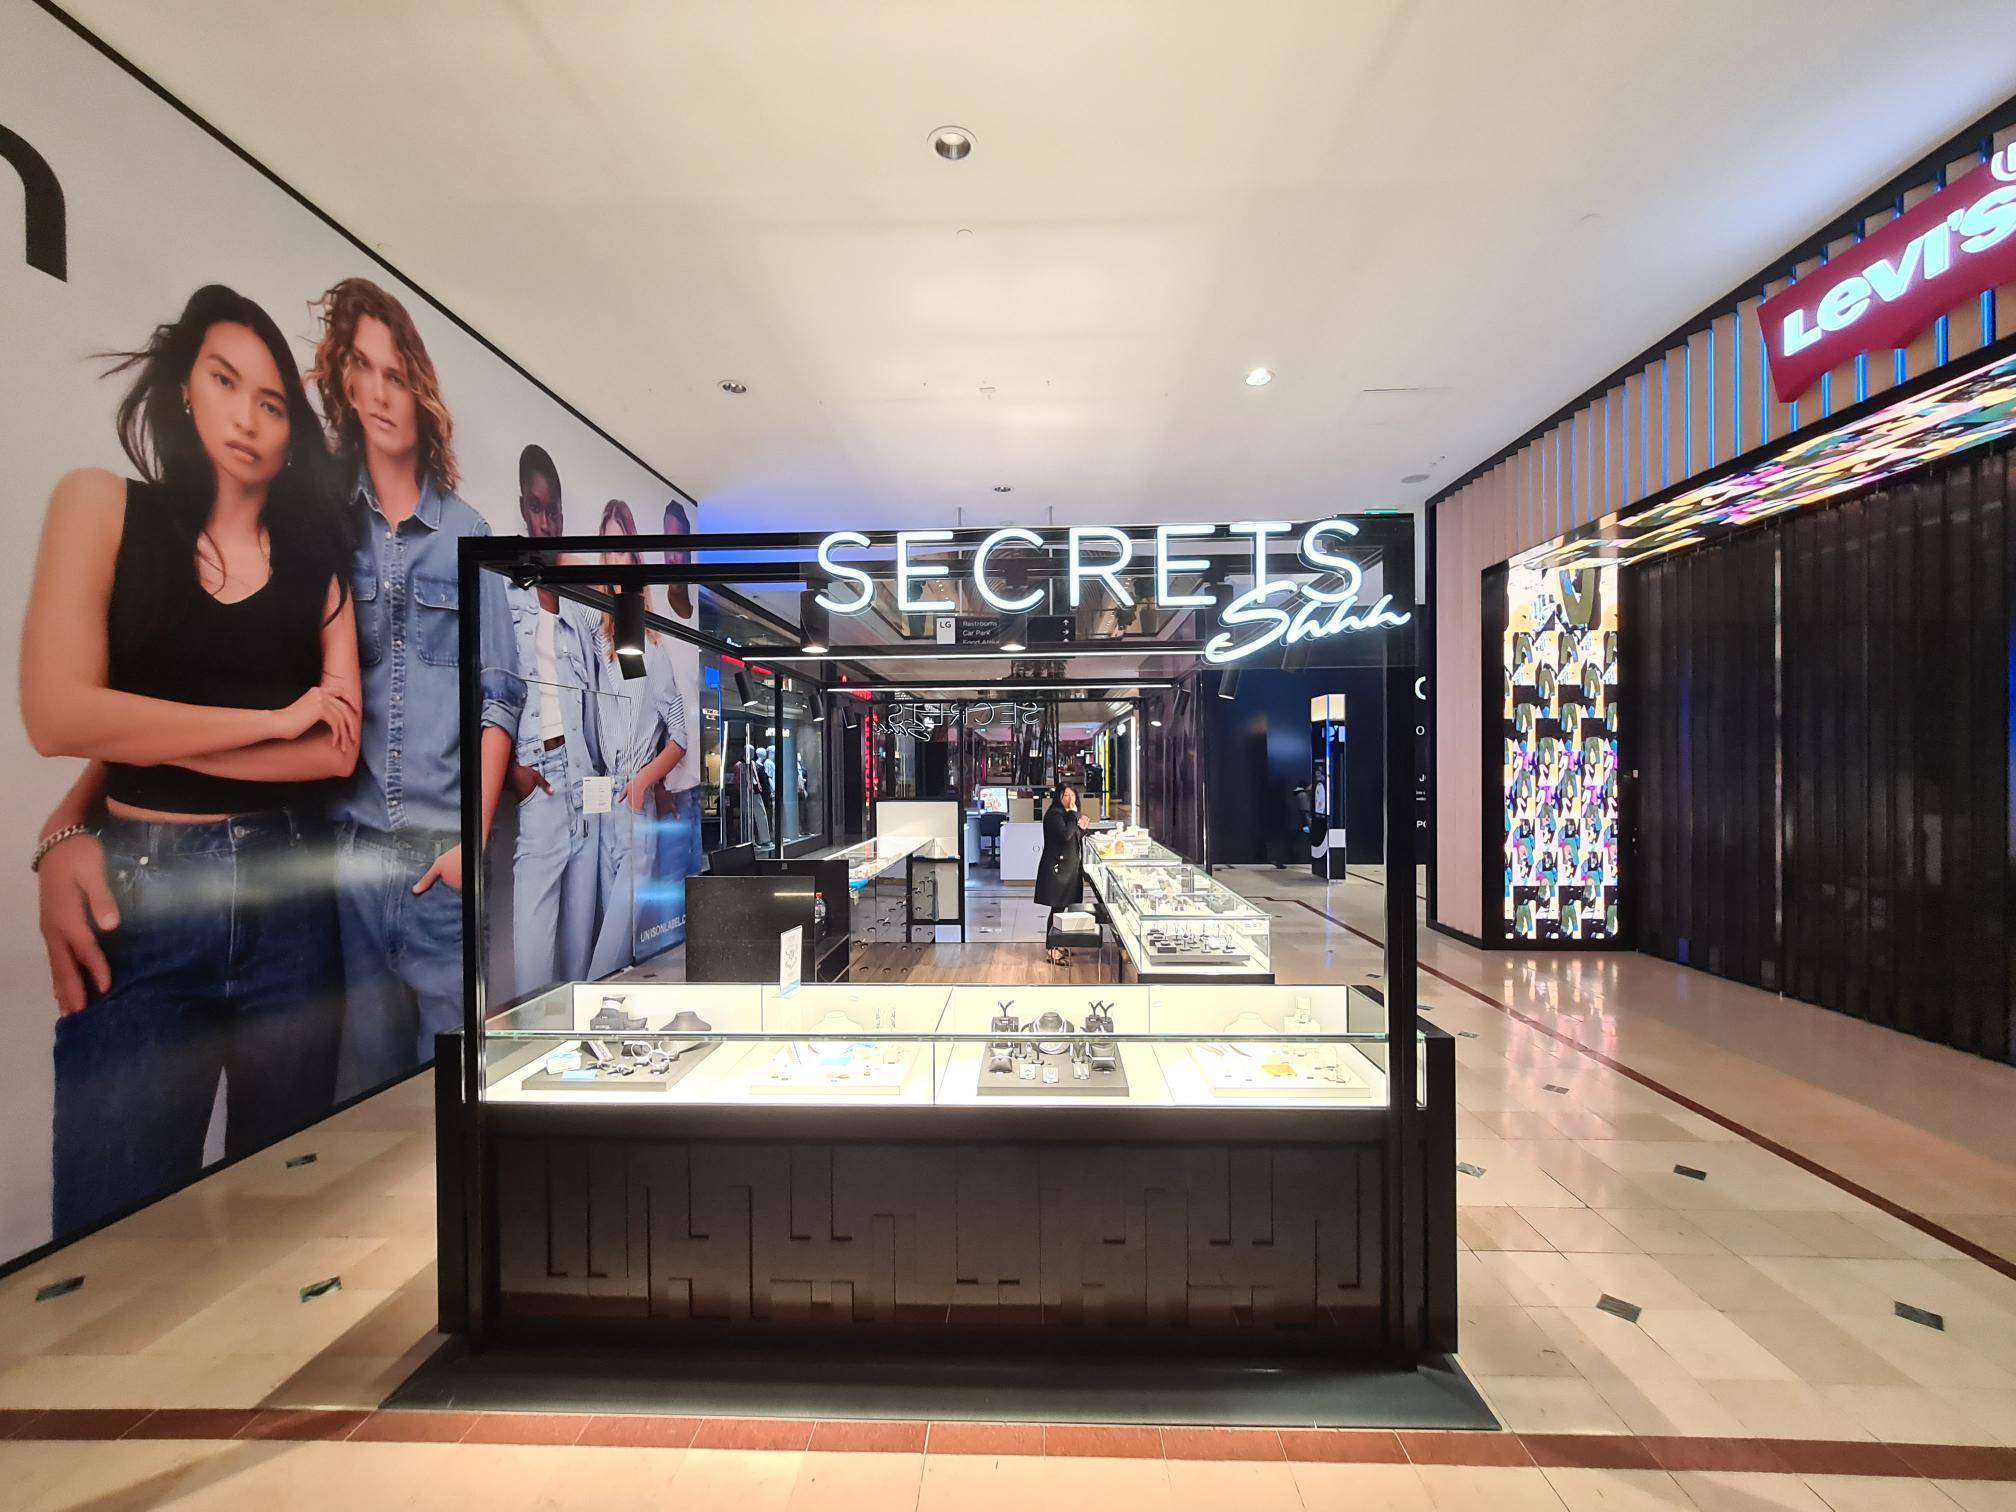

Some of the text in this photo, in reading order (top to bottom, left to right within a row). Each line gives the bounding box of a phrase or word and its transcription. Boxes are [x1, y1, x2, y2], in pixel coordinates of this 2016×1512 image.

[814, 518, 1363, 613] SECRETS
[939, 621, 952, 629] LG
[975, 629, 991, 637] Park
[1201, 581, 1411, 664] Shhh
